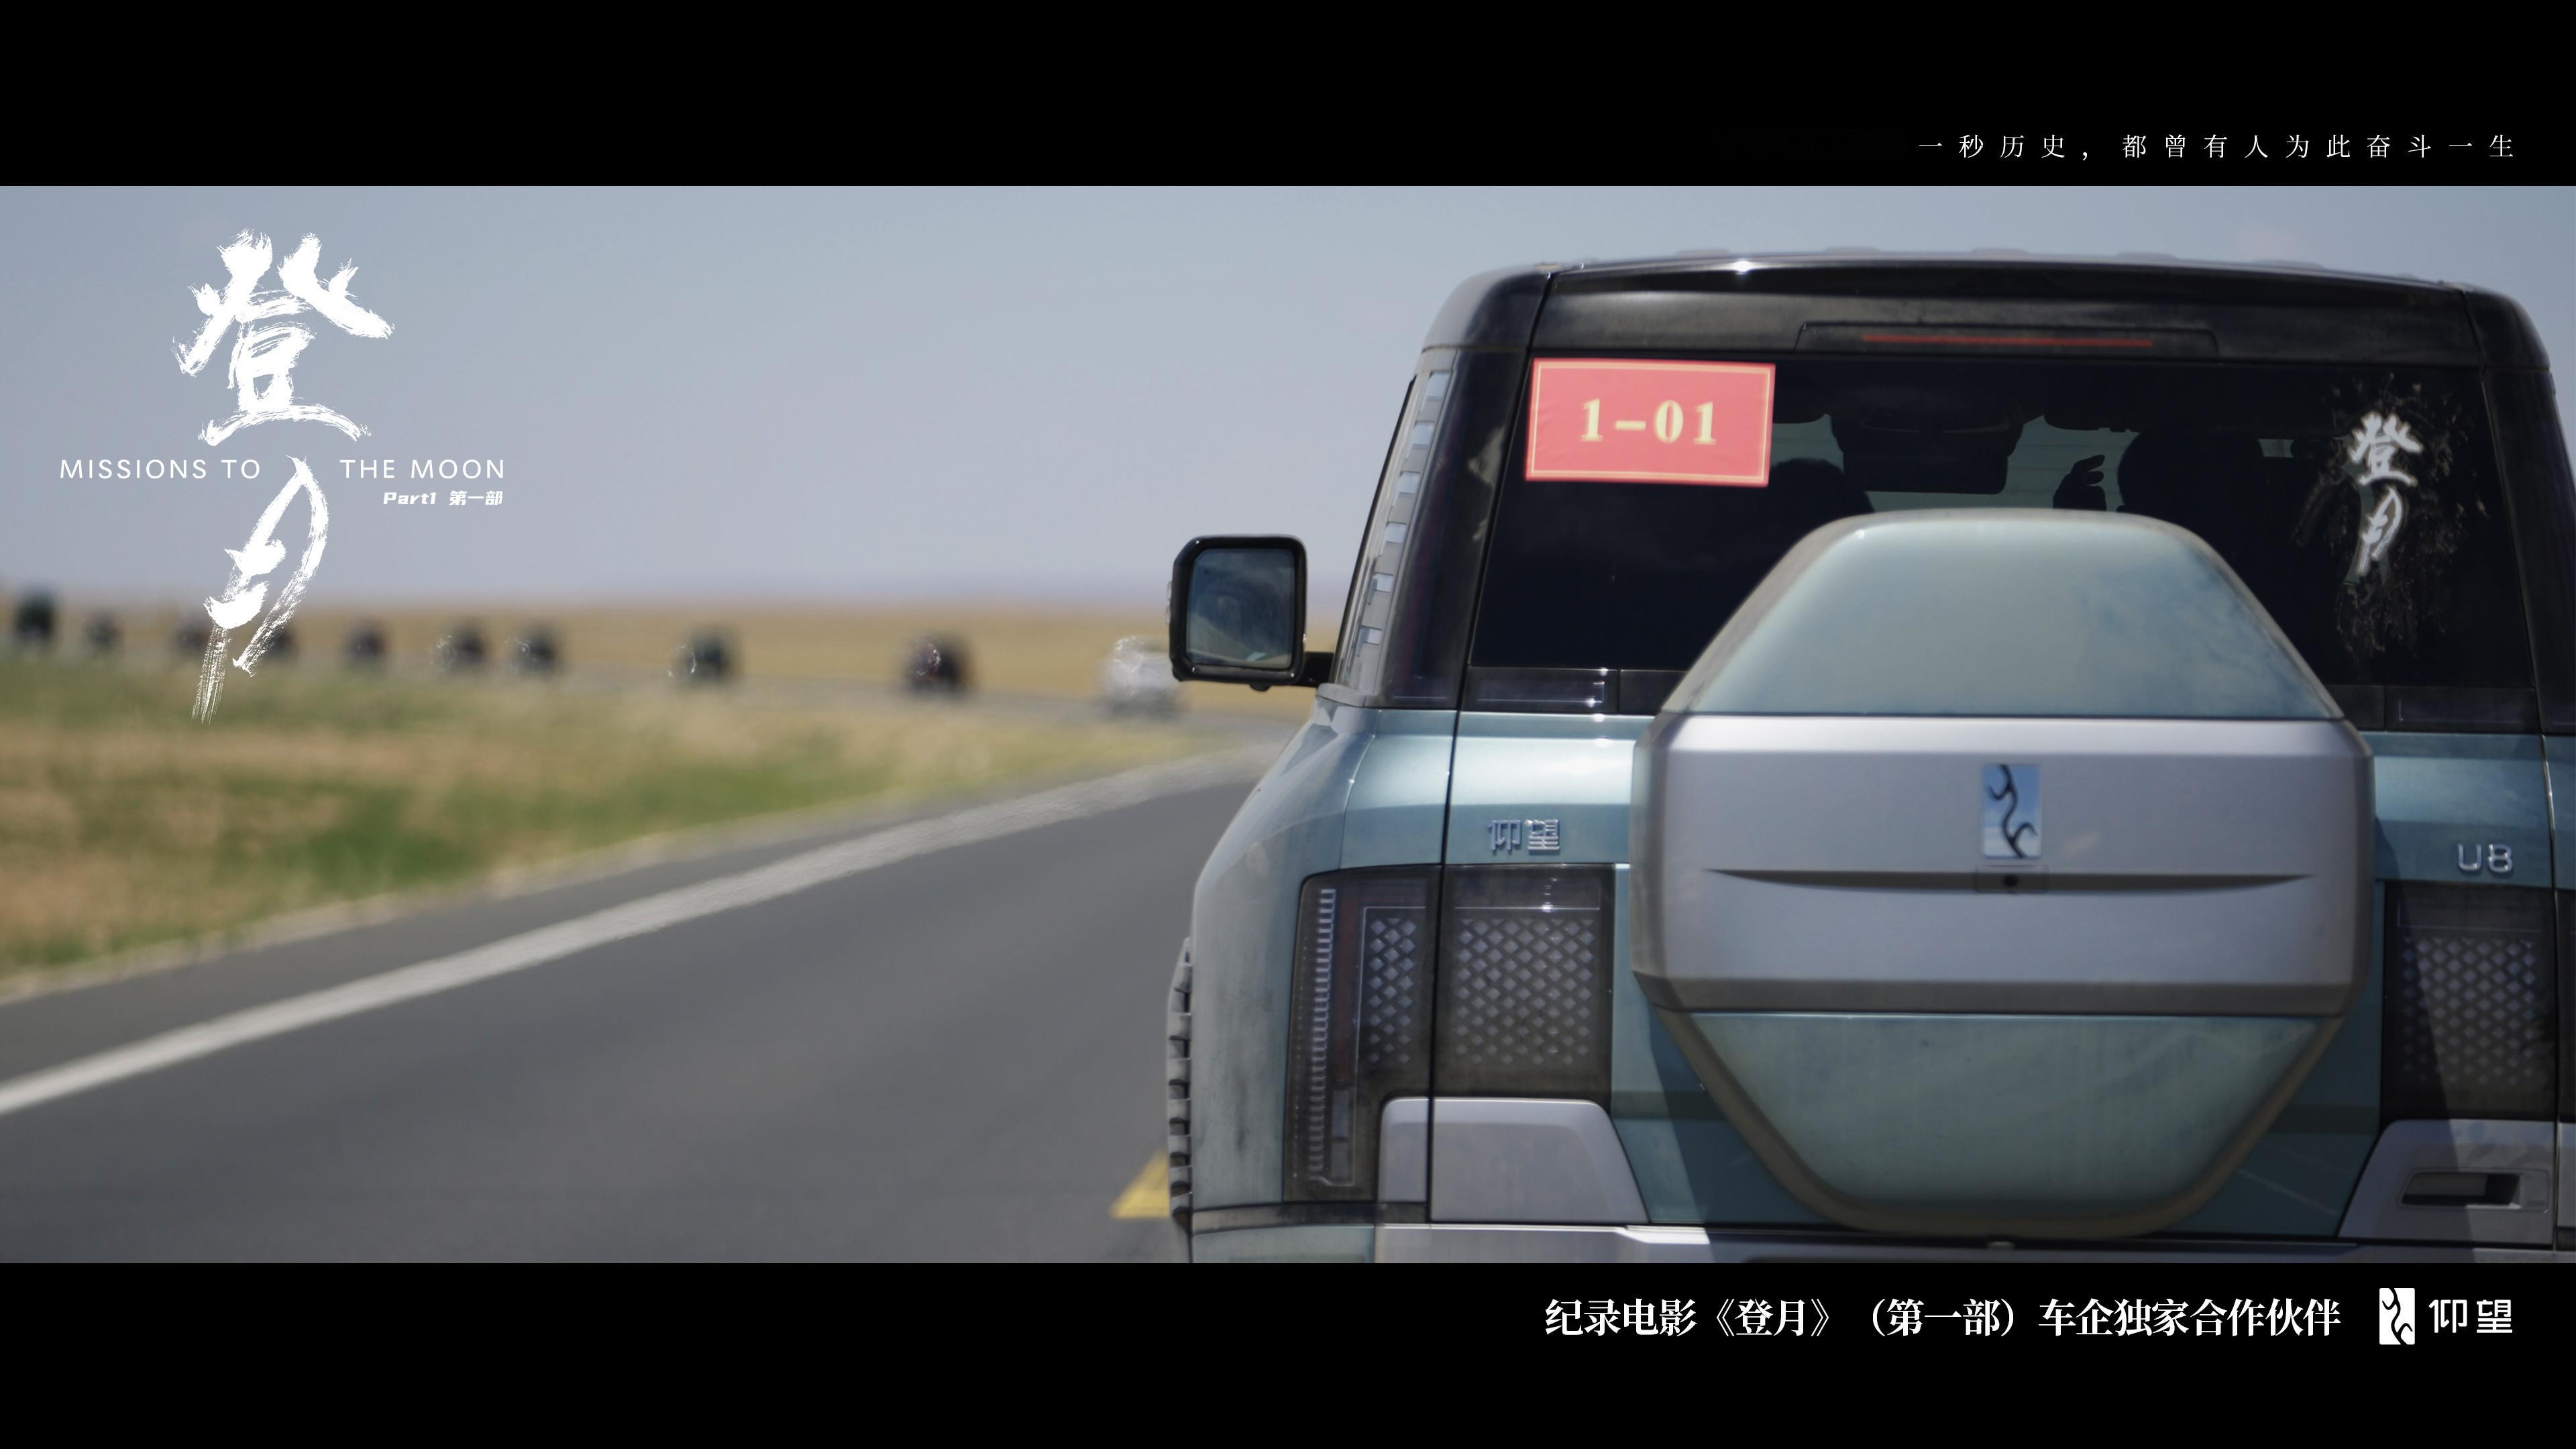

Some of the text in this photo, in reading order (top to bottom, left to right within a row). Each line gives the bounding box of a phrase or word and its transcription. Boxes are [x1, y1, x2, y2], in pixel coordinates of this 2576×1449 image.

[1580, 398, 1717, 445] 1-01
[2349, 411, 2424, 576] 登月
[1487, 819, 1560, 855] 仰望
[2457, 843, 2514, 873] U8
